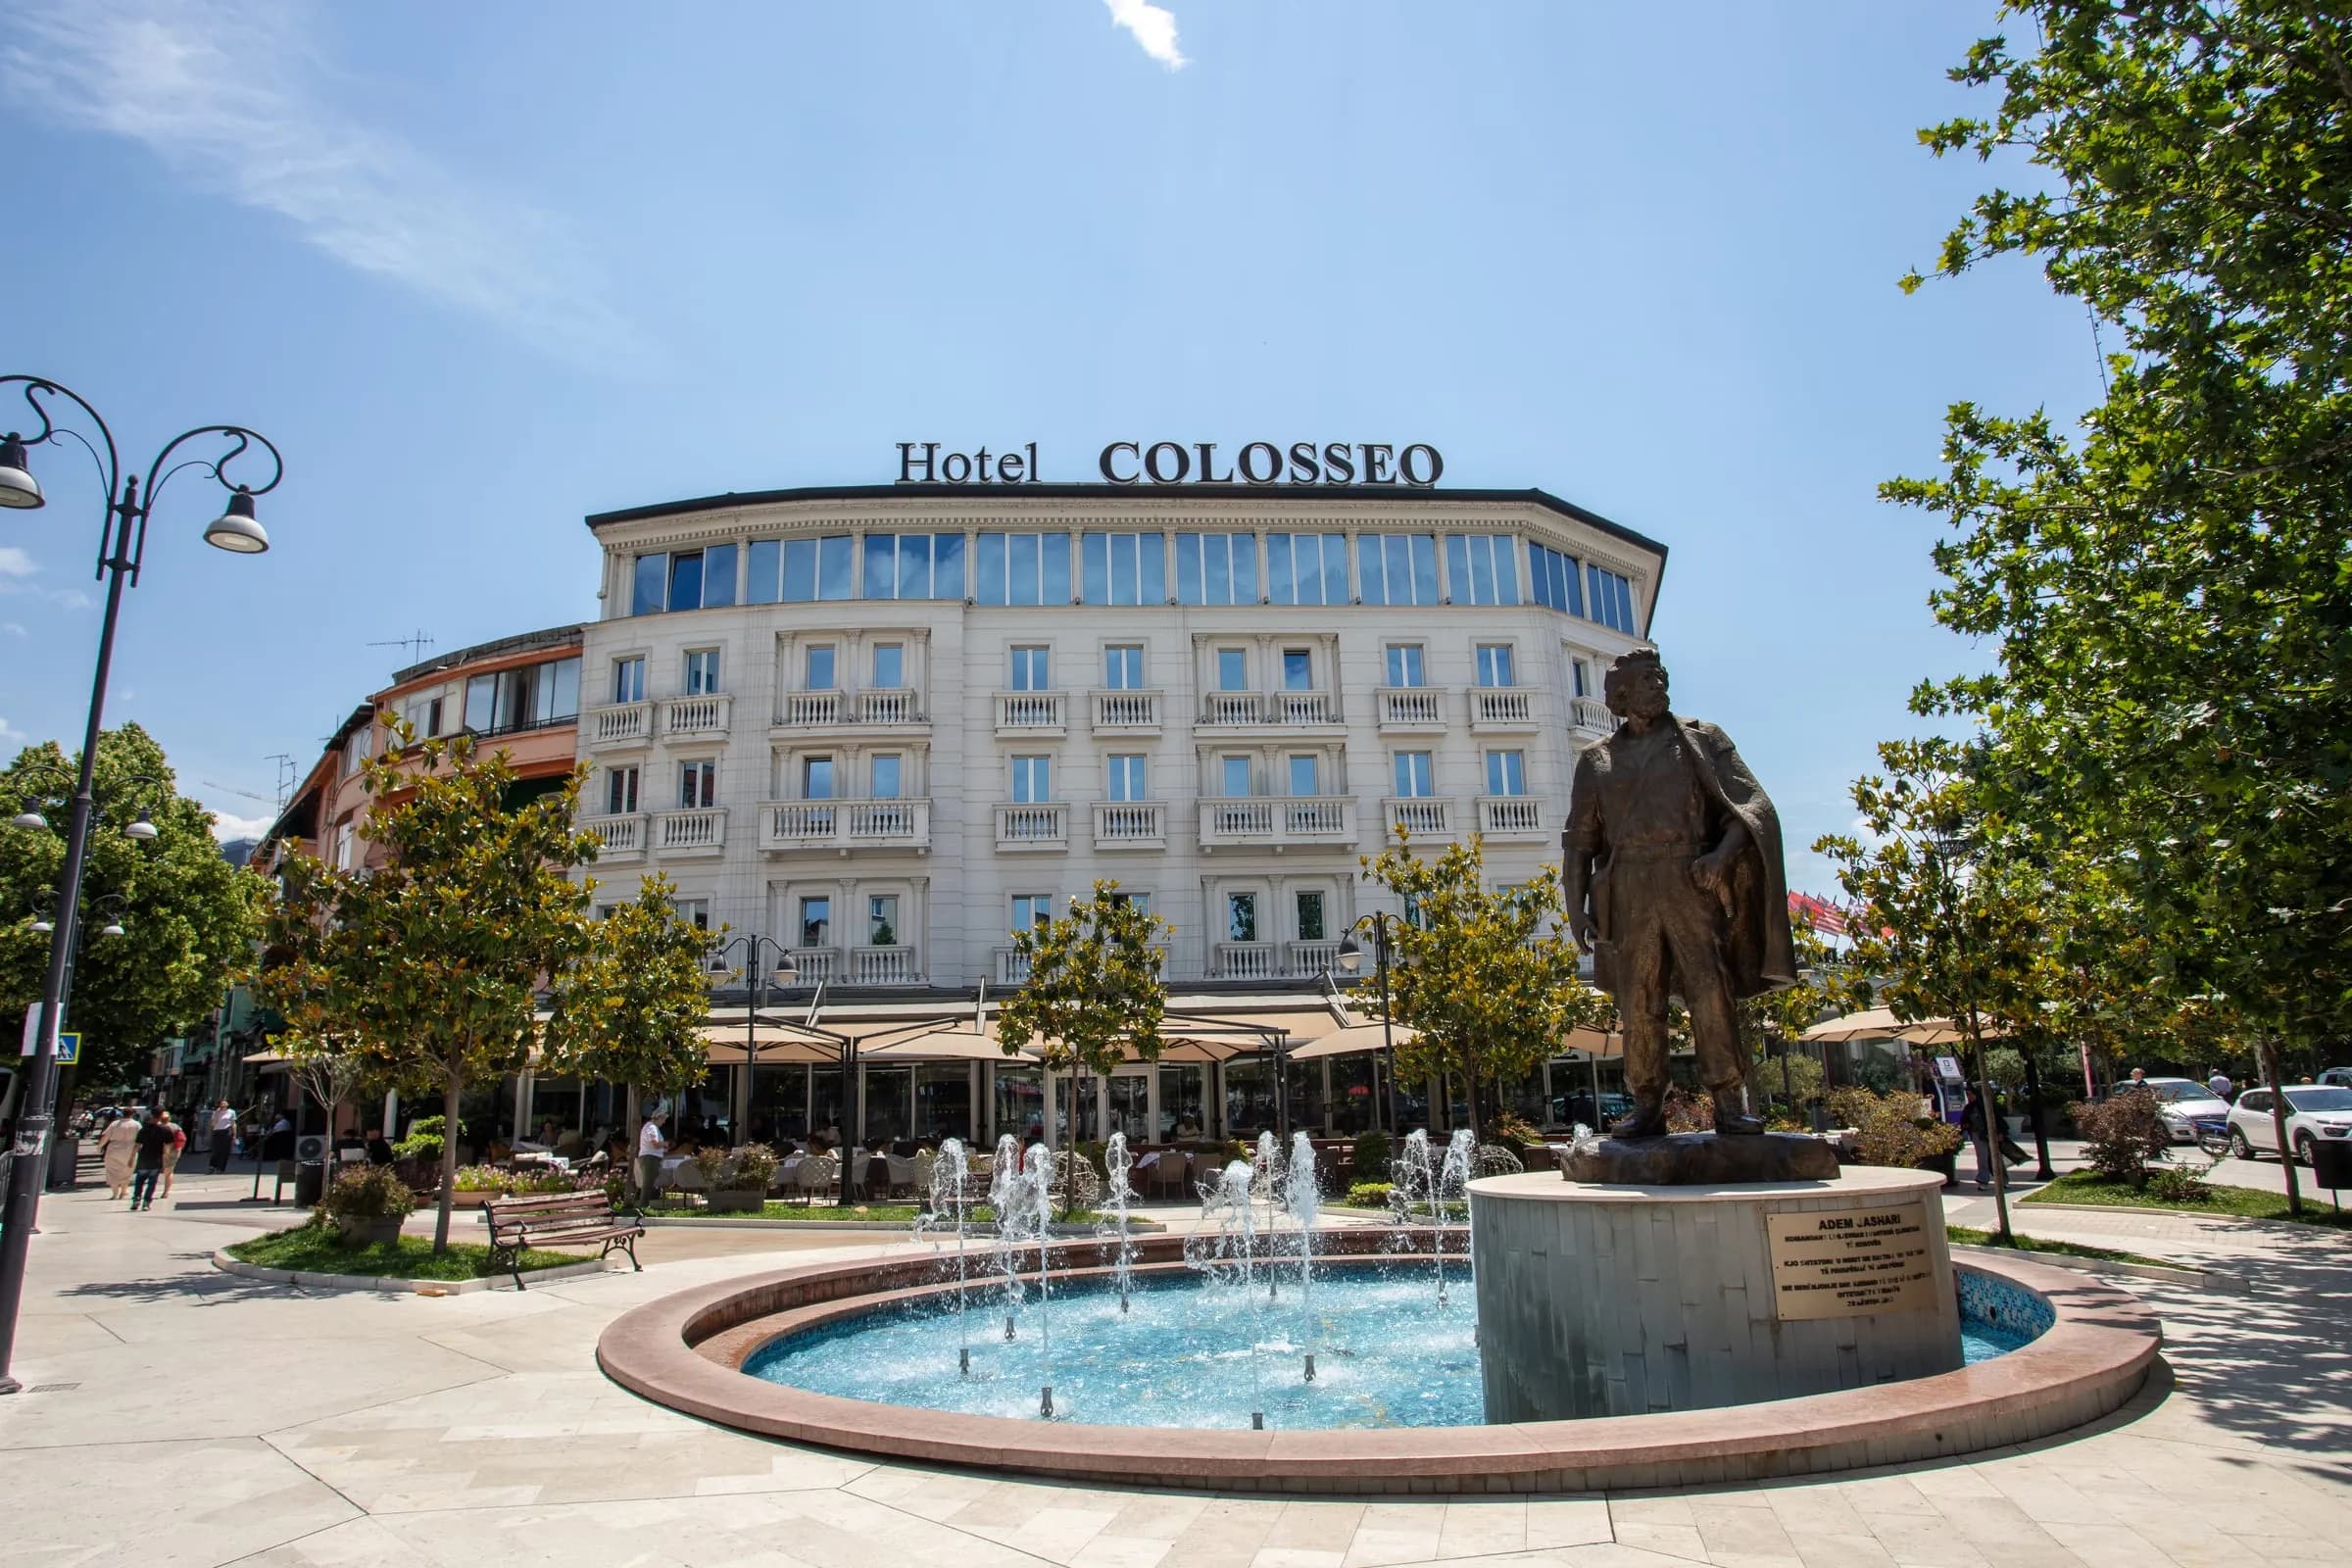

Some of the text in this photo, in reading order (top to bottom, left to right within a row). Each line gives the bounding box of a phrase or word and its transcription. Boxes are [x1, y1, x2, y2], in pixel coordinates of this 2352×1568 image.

[895, 441, 1444, 487] Hotel COLOSSEO
[1819, 1214, 1901, 1230] ADEM JASHARI
